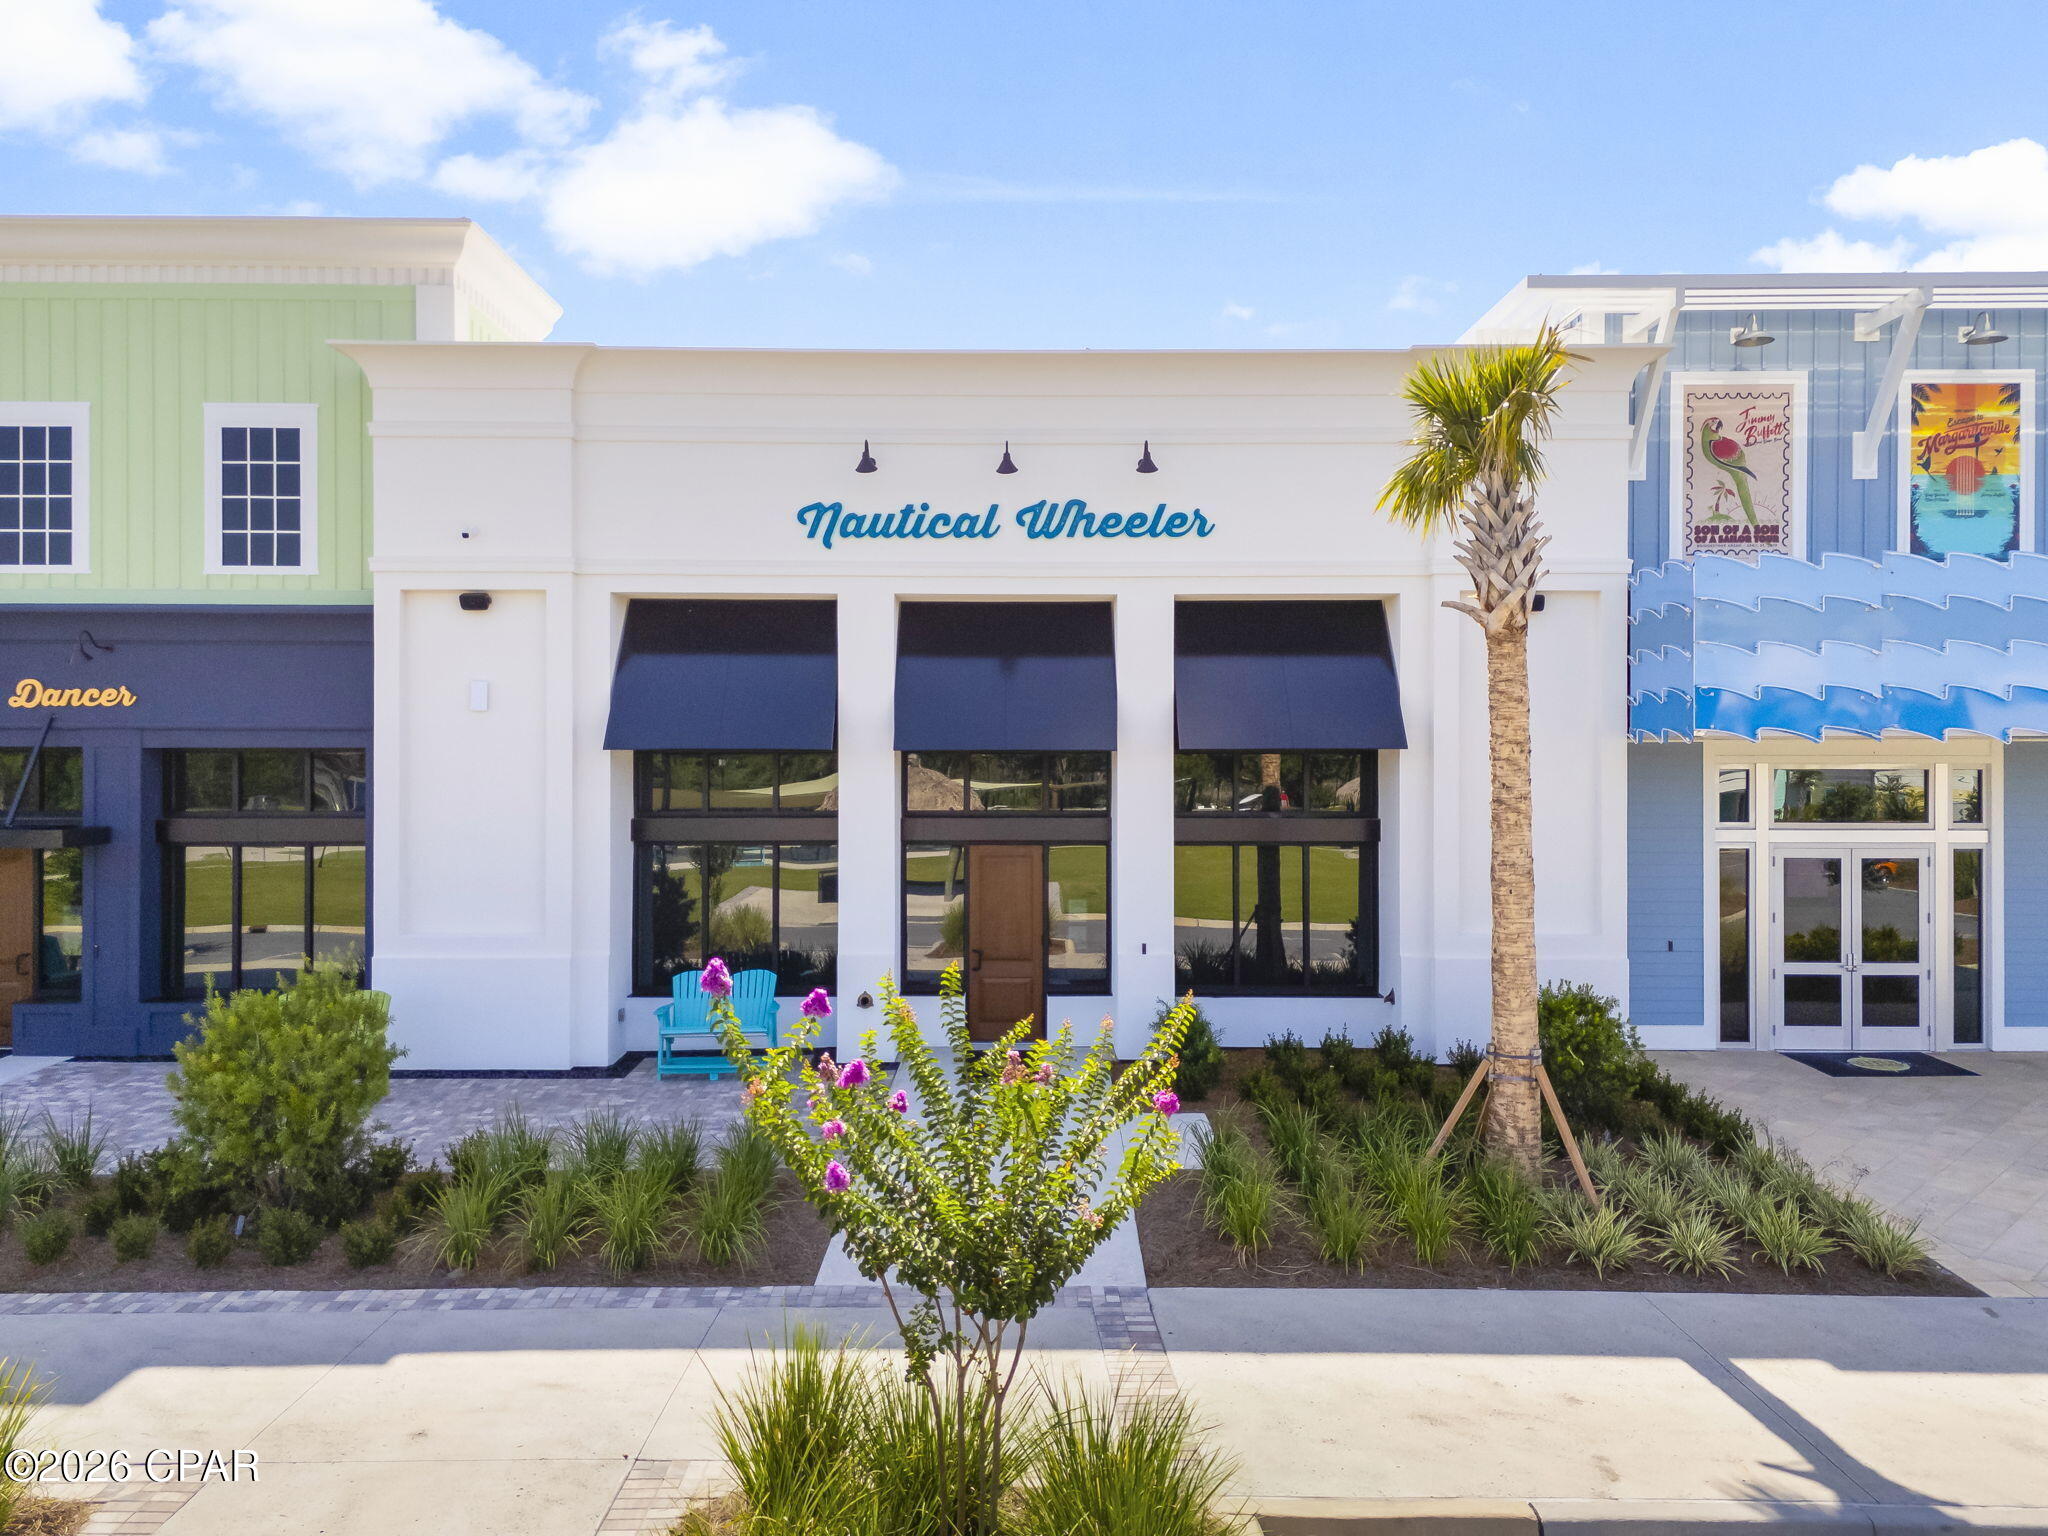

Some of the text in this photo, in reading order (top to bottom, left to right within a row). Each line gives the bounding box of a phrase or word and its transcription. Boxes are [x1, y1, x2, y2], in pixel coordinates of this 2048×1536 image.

[1735, 405, 1776, 433] Jimmy
[1743, 422, 1784, 447] Buffett
[1916, 419, 2011, 460] Margaritaville
[797, 499, 1216, 550] Nautical Wheeler
[1694, 525, 1780, 535] SON OF A SON
[1693, 534, 1780, 544] OF A SAILOR TOUR
[8, 678, 138, 709] Dancer
